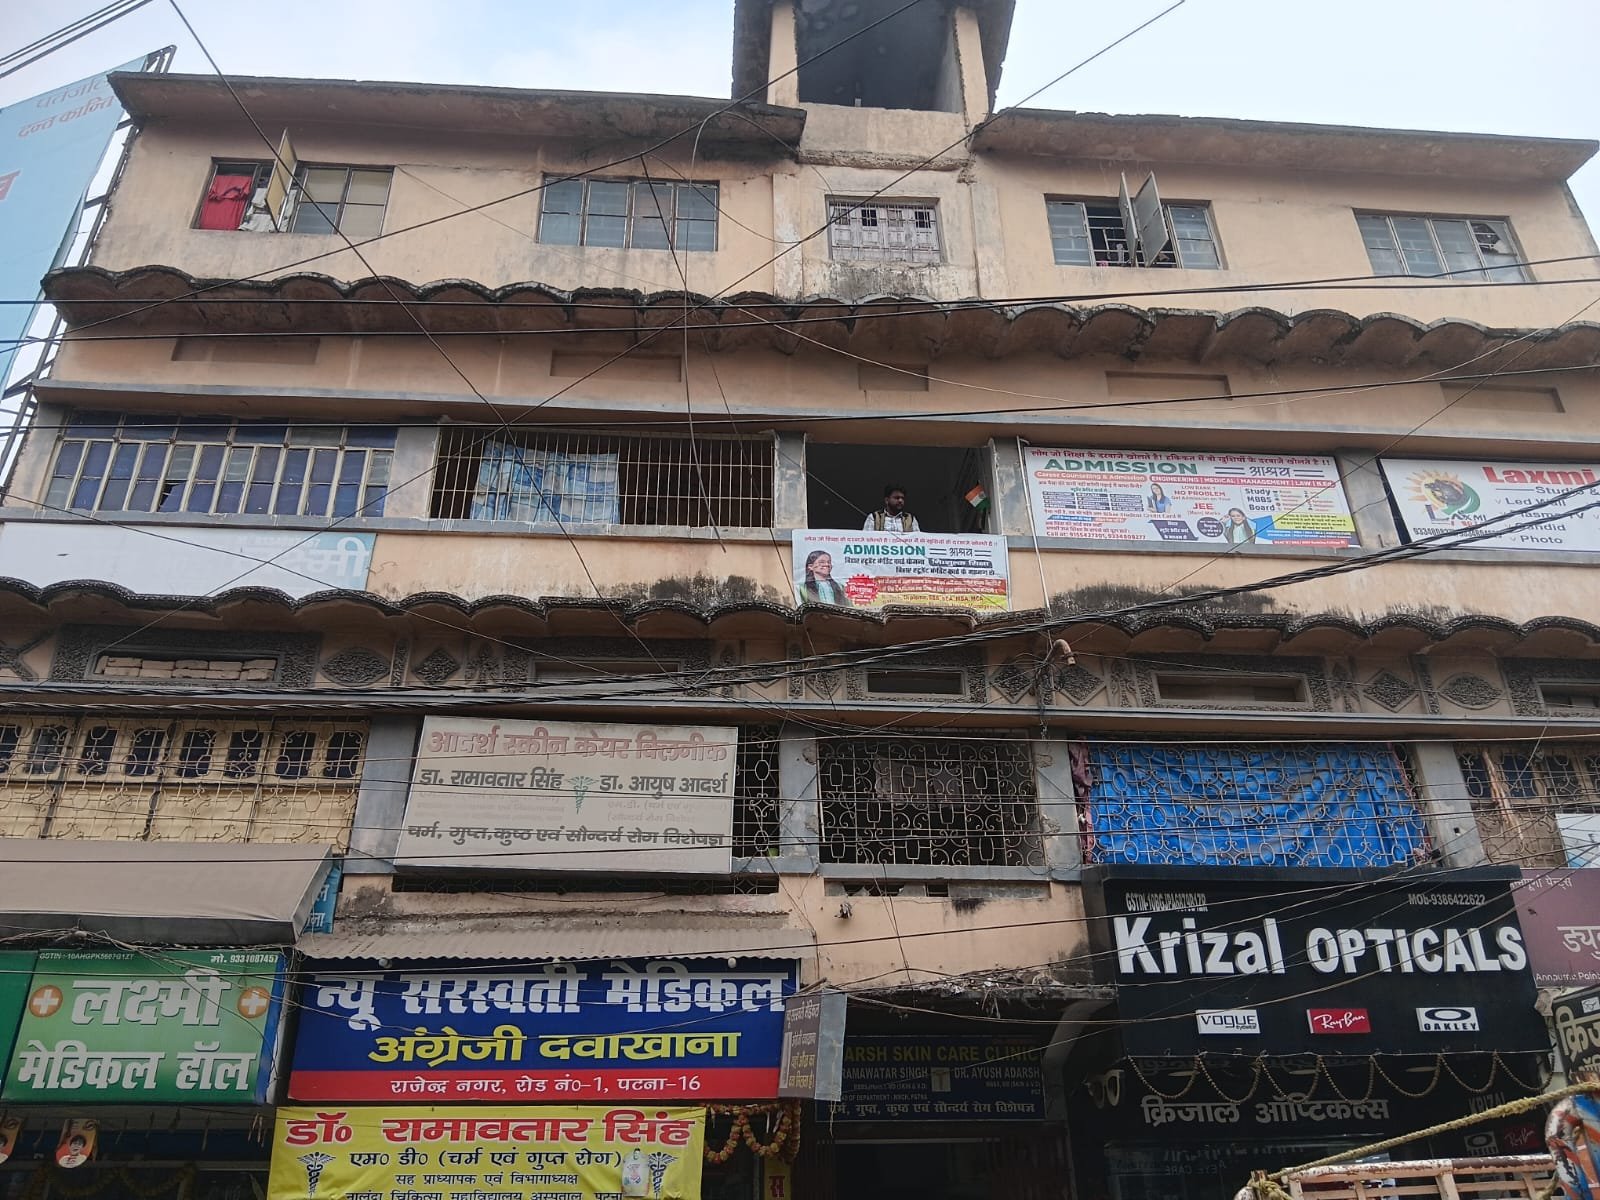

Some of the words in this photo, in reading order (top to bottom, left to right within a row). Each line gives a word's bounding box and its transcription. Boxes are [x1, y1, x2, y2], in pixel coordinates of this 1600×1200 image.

[1044, 459, 1198, 475] ADMISSION
[1249, 465, 1291, 478] आश्रय
[1482, 466, 1596, 485] Laxmi
[1151, 475, 1199, 483] ENGINEERING
[1204, 477, 1236, 485] MEDICAL
[1245, 488, 1270, 497] Study
[1505, 497, 1532, 505] Led
[1193, 502, 1215, 510] JEE
[1520, 535, 1563, 544] Photo
[844, 545, 925, 555] ADMISSION
[431, 725, 500, 755] आदर्श
[504, 727, 568, 757] स्कीन
[574, 731, 632, 760] केयर
[420, 769, 444, 787] डा.
[451, 770, 527, 788] रामावतार
[530, 767, 565, 790] सिंह
[600, 774, 623, 791] डा.
[629, 775, 676, 799] आयुष
[679, 772, 729, 794] आदर्श
[407, 820, 443, 841] चर्म,
[536, 825, 564, 842] एवं
[627, 826, 659, 843] रोग
[1113, 917, 1285, 976] Krizal
[1306, 926, 1527, 974] OPTICALS
[71, 968, 233, 1026] लक्ष्मी
[313, 973, 385, 1032] न्यू
[400, 960, 588, 1014] सरस्वती
[602, 960, 789, 1014] मेडिकल
[1201, 1015, 1256, 1028] VOGUE
[1424, 1022, 1477, 1031] OAKLEY
[368, 1024, 527, 1068] अंग्रेजी
[539, 1031, 741, 1061] दवाखाना
[844, 1046, 888, 1063] ARSH
[893, 1046, 932, 1063] SKIN
[936, 1045, 979, 1063] CARE
[18, 1040, 165, 1090] मेडिकल
[176, 1040, 256, 1091] हॉल
[900, 1066, 928, 1079] SINGH
[954, 1067, 971, 1079] DR.
[972, 1067, 1002, 1079] AYUSH
[1004, 1067, 1040, 1079] ADARSH
[390, 1074, 449, 1094] राजेन्द्र
[456, 1077, 507, 1093] नगर,
[515, 1074, 548, 1092] रोड
[617, 1075, 702, 1092] पटना-16
[856, 1103, 881, 1117] गुप्त,
[913, 1102, 930, 1114] एवं
[973, 1102, 991, 1114] रोग
[1141, 1095, 1240, 1127] क्रिजाल
[1255, 1092, 1390, 1123] ऑप्टिकल्स
[382, 1117, 593, 1142] रामावतार
[602, 1109, 695, 1145] सिंह
[439, 1147, 483, 1167] (चर्म
[490, 1146, 519, 1166] एवं
[526, 1151, 570, 1170] गुप्त
[576, 1148, 621, 1168] रोग)
[395, 1174, 416, 1186] सह
[423, 1174, 477, 1186] प्राध्यापक
[484, 1172, 504, 1187] एवं
[510, 1172, 578, 1186] विभागाध्यक्ष
